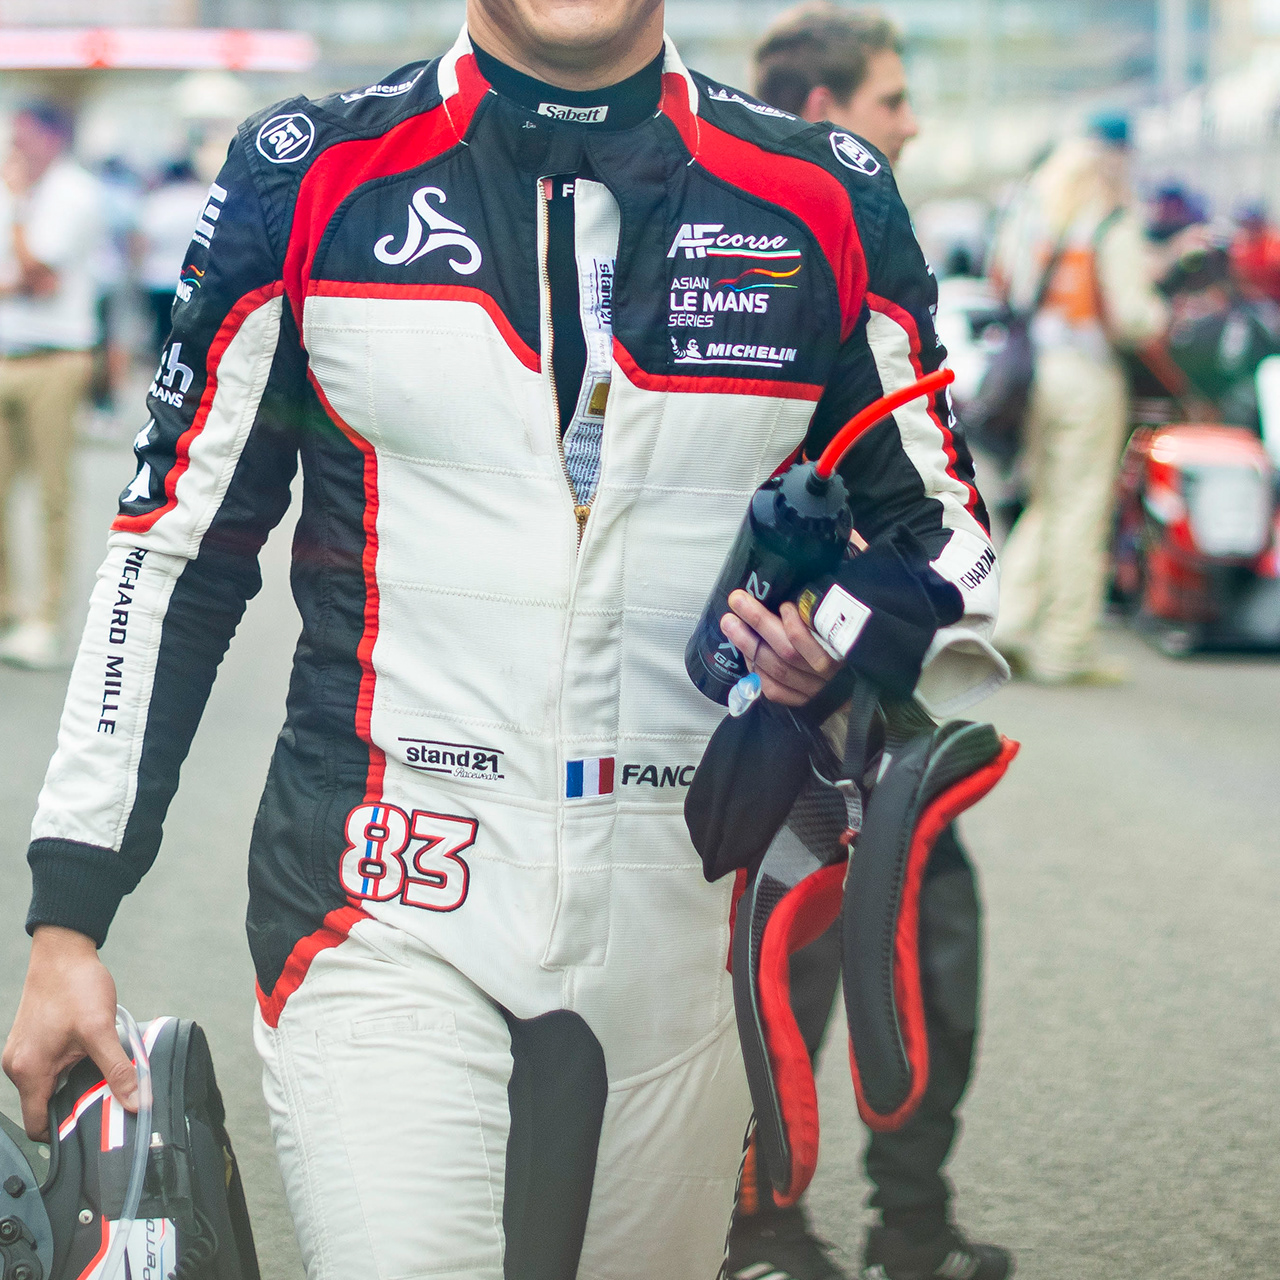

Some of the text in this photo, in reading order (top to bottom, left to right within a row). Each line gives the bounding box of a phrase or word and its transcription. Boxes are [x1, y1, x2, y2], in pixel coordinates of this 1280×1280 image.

[546, 105, 600, 121] Sabelt
[268, 122, 303, 154] 21
[671, 277, 709, 290] ASIAN
[670, 292, 770, 313] LE MANS
[668, 314, 715, 327] SERIES
[706, 343, 798, 361] MICHELIN
[97, 546, 151, 735] RICHARD MILLE
[713, 651, 739, 669] GP
[453, 767, 498, 781] Racewear
[339, 801, 479, 912] 83
